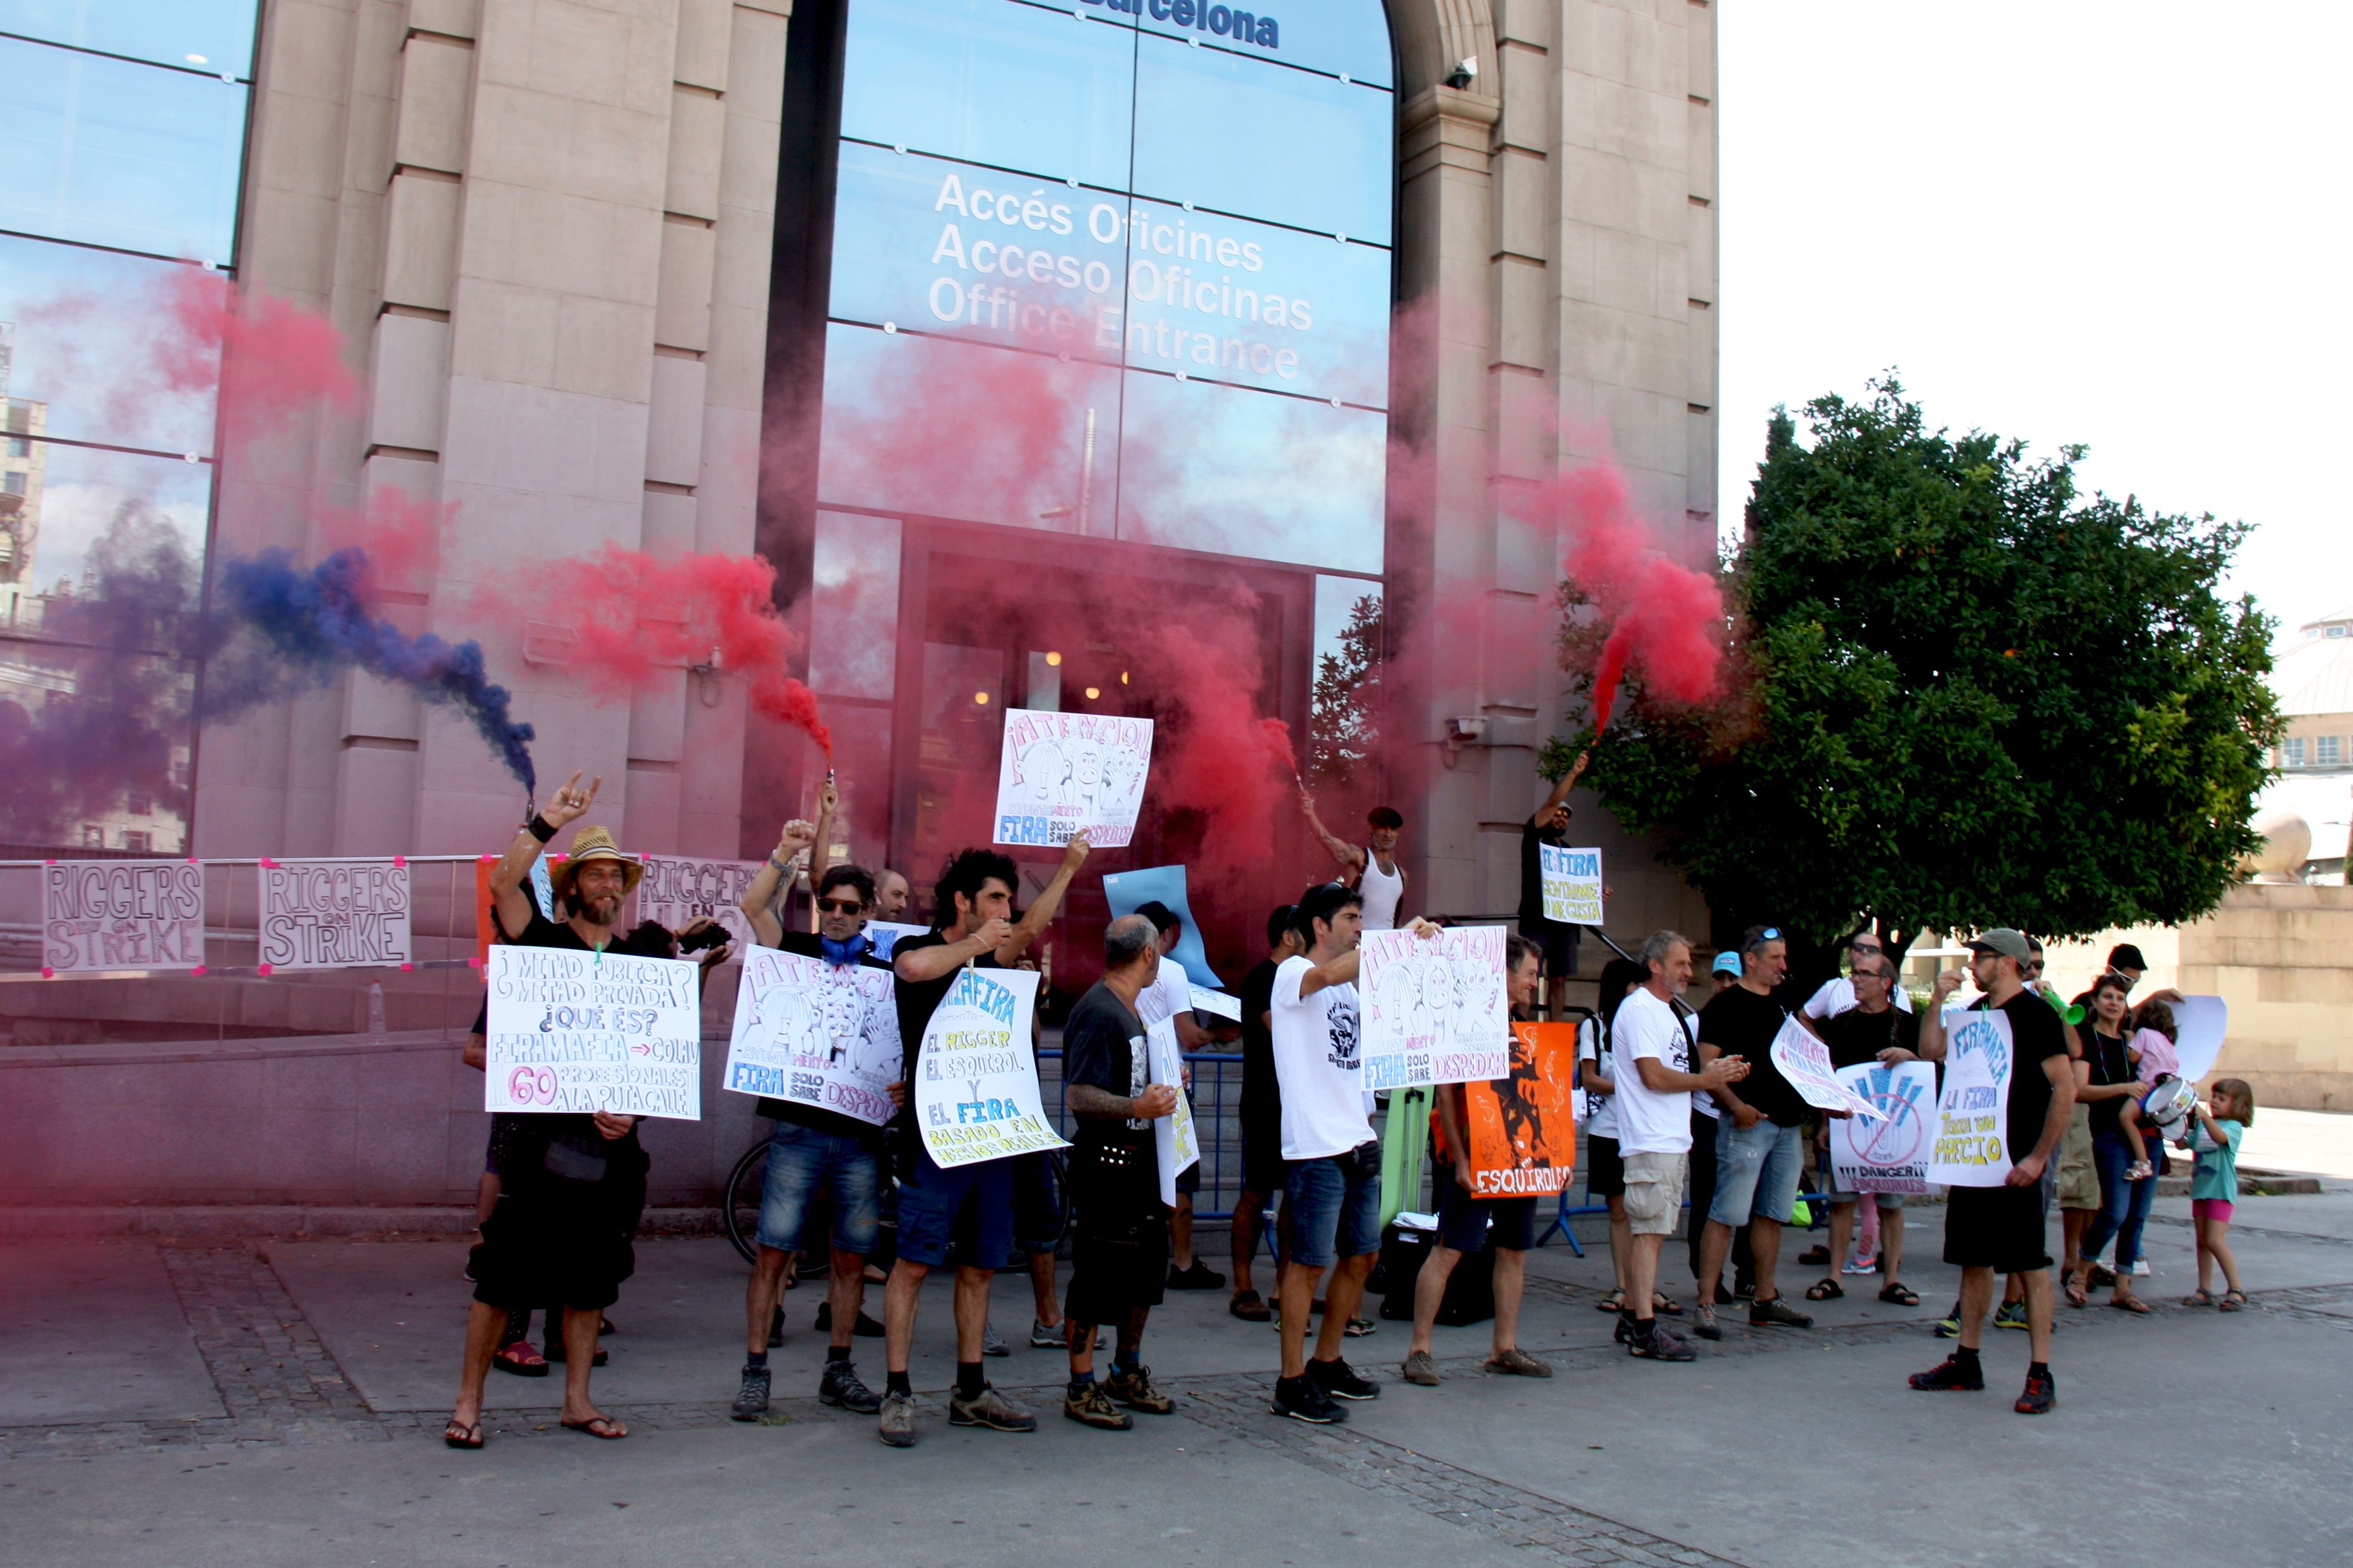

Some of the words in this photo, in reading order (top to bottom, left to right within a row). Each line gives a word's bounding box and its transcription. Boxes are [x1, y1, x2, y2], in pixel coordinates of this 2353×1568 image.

[935, 174, 1072, 235] Accés
[1089, 203, 1263, 272] Oficines
[932, 224, 1111, 294] Acceso
[1128, 259, 1313, 331] Oficinas
[929, 278, 1076, 341] Office
[1095, 306, 1299, 379] Entrance
[999, 815, 1048, 844] FIRA
[1049, 821, 1076, 832] SOLO
[48, 865, 200, 920] RIGGERS
[267, 867, 408, 914] RIGGERS
[324, 912, 352, 925] ON
[691, 904, 714, 917] EN
[113, 920, 138, 934] ON
[264, 912, 405, 965] STRIKE
[47, 921, 201, 969] STRIKE
[518, 952, 583, 979] MITAD
[591, 958, 672, 986] PUBLICA
[516, 980, 585, 1003] MITAD
[591, 982, 677, 1008] PRIVADA
[540, 1004, 605, 1032] ¿QUÉ
[490, 1032, 629, 1063] FIRAMAFIA
[651, 1037, 700, 1065] COLAU
[927, 1034, 940, 1054] EL
[946, 1030, 1011, 1052] RIGGER
[926, 1059, 943, 1081] EL
[946, 1051, 1024, 1078] ESQUIROL
[1365, 1053, 1406, 1089] FIRA
[1407, 1053, 1430, 1068] SOLO
[1408, 1067, 1431, 1083] SABE
[1433, 1052, 1506, 1080] DESPEDIR
[508, 1066, 557, 1105] 60
[732, 1062, 784, 1095] FIRA
[790, 1072, 824, 1087] SOLO
[790, 1084, 821, 1102] SABE
[967, 1079, 981, 1103] Y
[928, 1102, 951, 1126] EL
[957, 1098, 1021, 1124] FIRA
[1963, 1086, 1996, 1109] FIRA
[928, 1124, 1000, 1147] BASADO
[1009, 1114, 1043, 1133] EN
[935, 1142, 1002, 1163] HECHOS
[997, 1132, 1065, 1153] REALES
[1933, 1136, 2001, 1165] PRECIO
